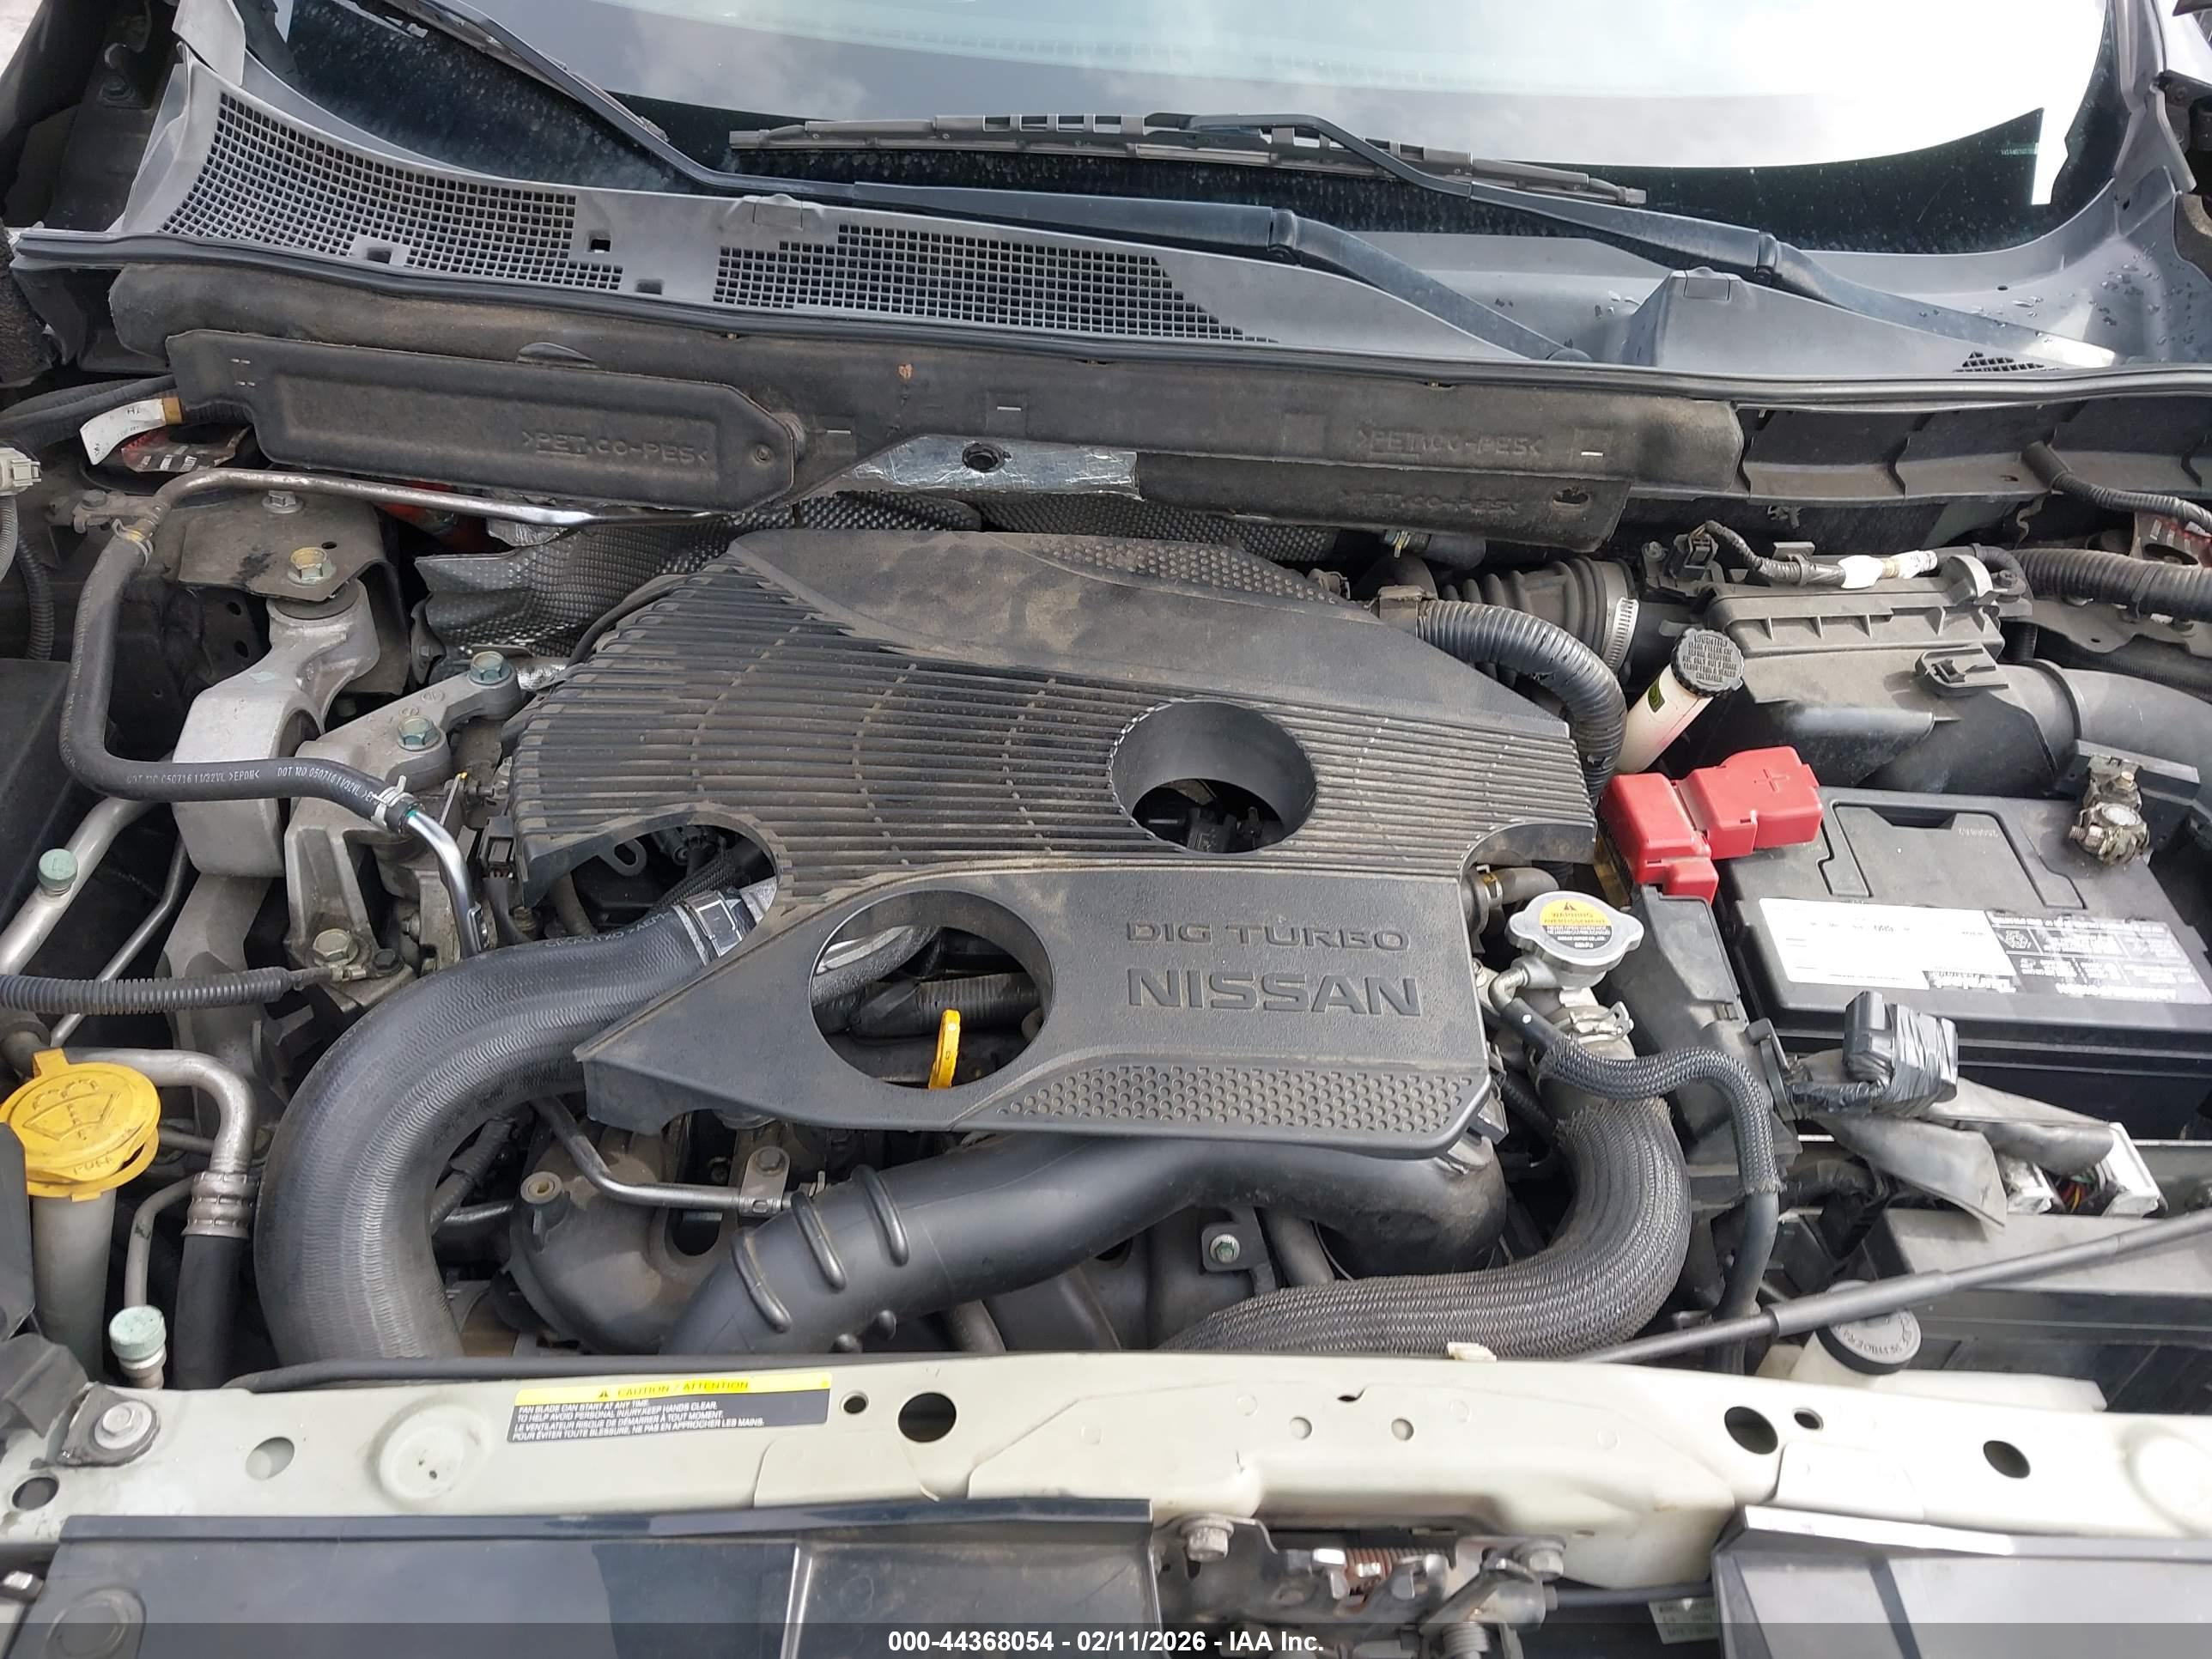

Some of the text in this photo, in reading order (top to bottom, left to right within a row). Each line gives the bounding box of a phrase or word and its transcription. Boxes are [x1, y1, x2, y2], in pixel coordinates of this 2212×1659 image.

[1127, 922, 1410, 951] DIG TURBO
[1127, 968, 1422, 1018] NISSAN
[617, 1385, 670, 1396] CAUTION
[683, 1381, 749, 1391] ATTENTION
[518, 1413, 528, 1423] TO
[529, 1413, 550, 1422] HELP
[550, 1411, 574, 1421] AVOID
[574, 1409, 615, 1420] PERSONAL
[662, 1402, 690, 1414] HANDS
[519, 1405, 534, 1414] FAN
[561, 1403, 578, 1413] CAN
[604, 1401, 614, 1409] AT
[614, 1401, 631, 1409] ANY
[513, 1432, 536, 1442] POUR
[563, 1428, 588, 1438] TOUTE
[632, 1425, 643, 1435] NE
[644, 1424, 659, 1433] PAS
[659, 1423, 672, 1432] EN
[672, 1419, 721, 1431] APPROCHER
[526, 1421, 575, 1431] VENTILATEUR
[605, 1418, 617, 1427] DE
[667, 1412, 688, 1423] TOUT
